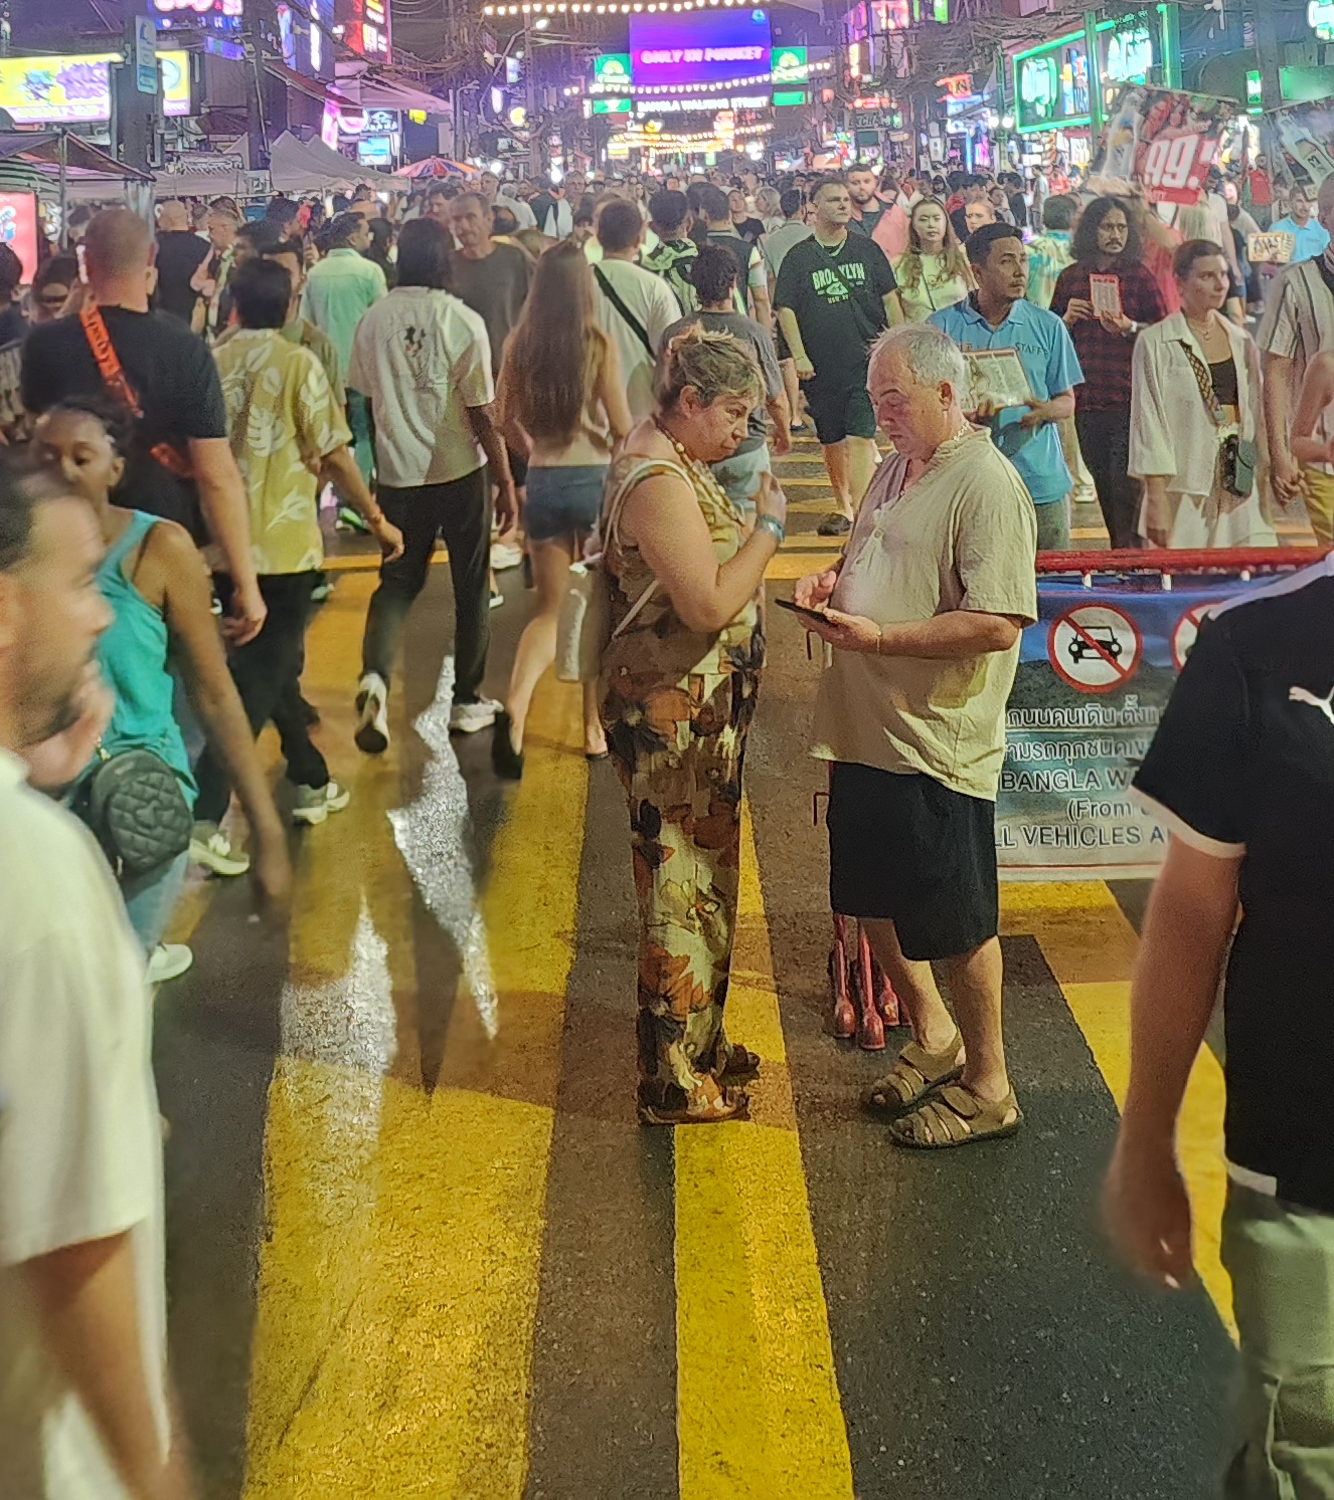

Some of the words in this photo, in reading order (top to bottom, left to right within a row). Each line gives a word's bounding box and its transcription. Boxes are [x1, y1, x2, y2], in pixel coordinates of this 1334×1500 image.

[640, 49, 683, 64] ONLY
[704, 46, 765, 62] PHUKET
[999, 770, 1102, 793] BANGLA
[1068, 797, 1132, 823] (From
[1022, 824, 1142, 848] VEHICLES
